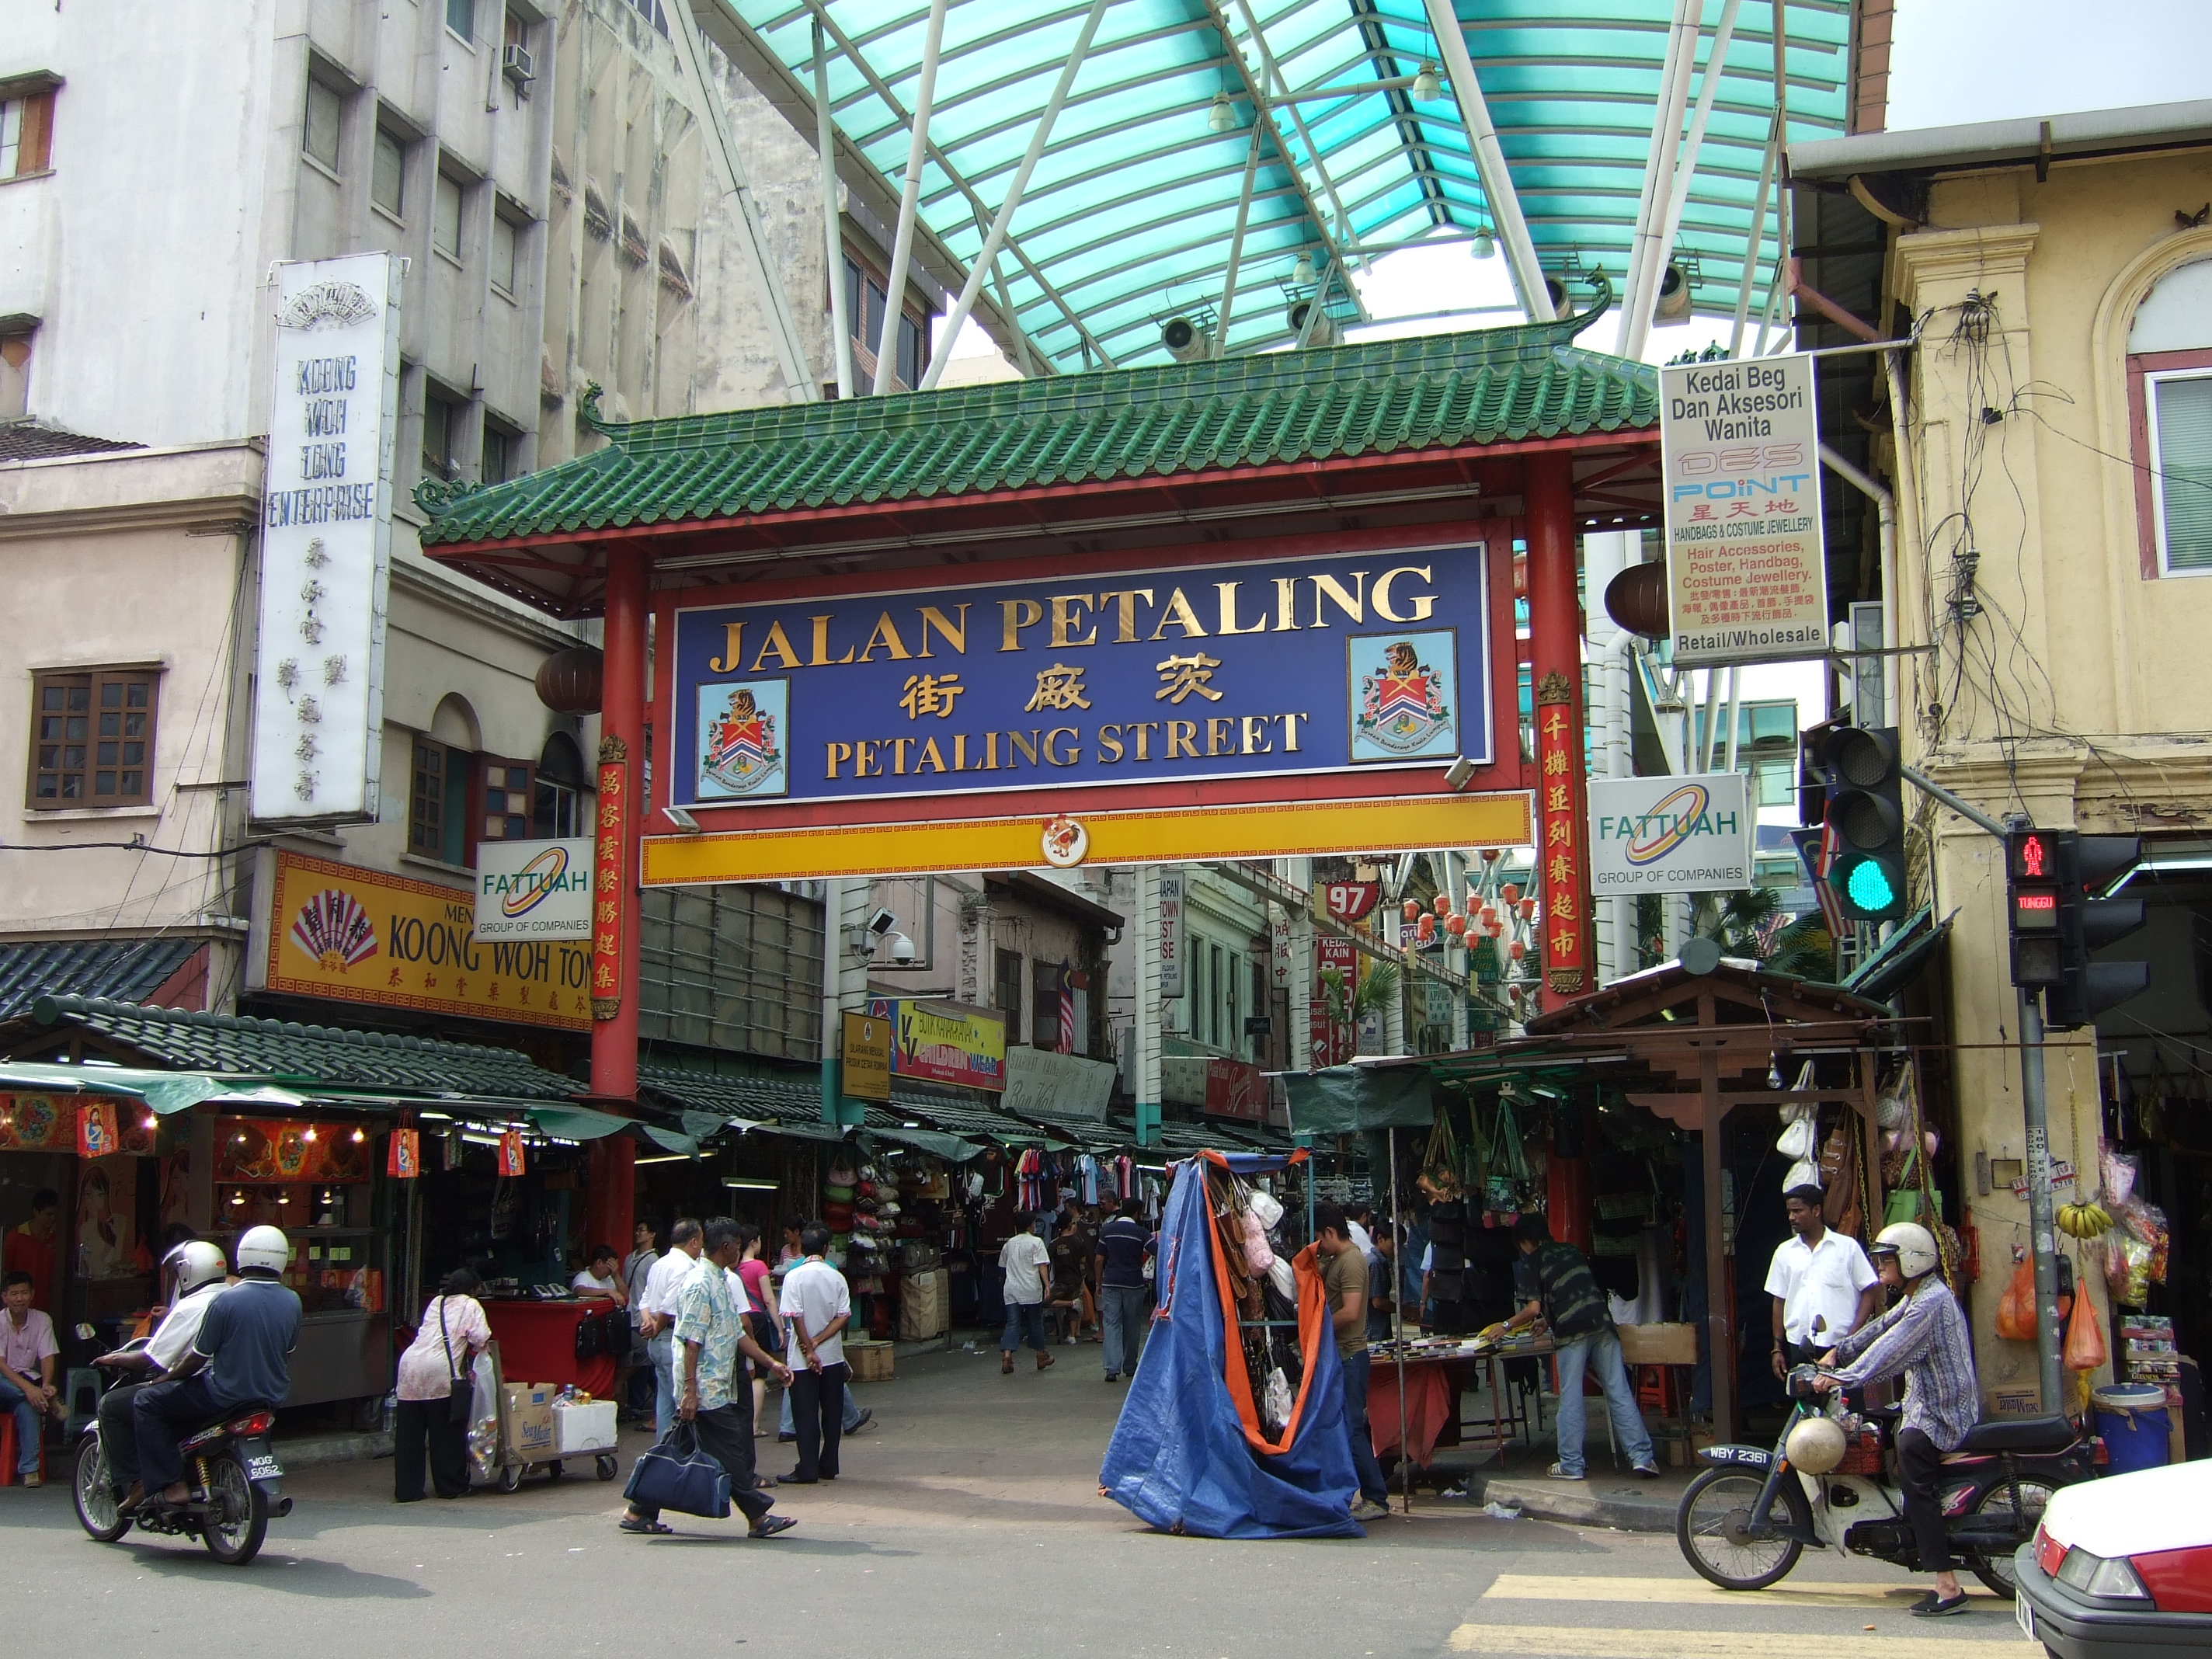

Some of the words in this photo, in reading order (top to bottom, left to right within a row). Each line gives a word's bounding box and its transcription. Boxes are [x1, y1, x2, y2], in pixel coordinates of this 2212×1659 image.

[297, 355, 356, 395] KOONG
[1686, 368, 1740, 395] Kedai
[1748, 366, 1785, 391] Beg
[1672, 398, 1709, 420] Dan
[1716, 386, 1803, 416] Aksesori
[304, 398, 346, 437] WOH
[1705, 416, 1771, 441] Wanita
[299, 442, 346, 481] TONG
[1678, 443, 1803, 476] DES
[267, 482, 374, 527] ENTERPRISE
[1688, 499, 1800, 523] 星天地
[1674, 524, 1718, 542] HANDBAGS
[1719, 525, 1724, 538] &
[1727, 520, 1765, 537] COSTUME
[1767, 516, 1814, 534] JEWELLERY
[1688, 548, 1714, 560] Hair
[1718, 542, 1804, 558] Accessories,
[1690, 562, 1736, 574] Poster,
[1739, 556, 1803, 571] Handbag,
[1682, 575, 1741, 589] Costume
[1746, 569, 1812, 584] Jewellery.
[709, 603, 972, 673] JALAN
[996, 565, 1438, 652] PETALING
[1678, 626, 1821, 651] Retail/Wholesale
[825, 727, 1081, 780] PETALING
[1097, 712, 1308, 764] STREET
[1599, 811, 1737, 840] FATTUAH
[483, 871, 587, 895] FATTUAH
[1598, 871, 1643, 883] GROUP
[1647, 870, 1664, 882] OF
[1668, 867, 1743, 881] COMPANIES
[1330, 886, 1365, 914] 97
[2018, 896, 2053, 909] TUNGGU
[479, 922, 513, 933] GROUP
[516, 921, 530, 931] OF
[532, 920, 589, 931] COMPANIES
[389, 915, 480, 972] KOONG
[493, 941, 550, 983] WOH
[1325, 948, 1349, 958] KAIN
[920, 1043, 968, 1070] CHILDREN
[970, 1052, 998, 1076] WEAR
[1710, 1447, 1734, 1459] WBY
[1738, 1450, 1767, 1463] 2361
[251, 1465, 280, 1476] 6062
